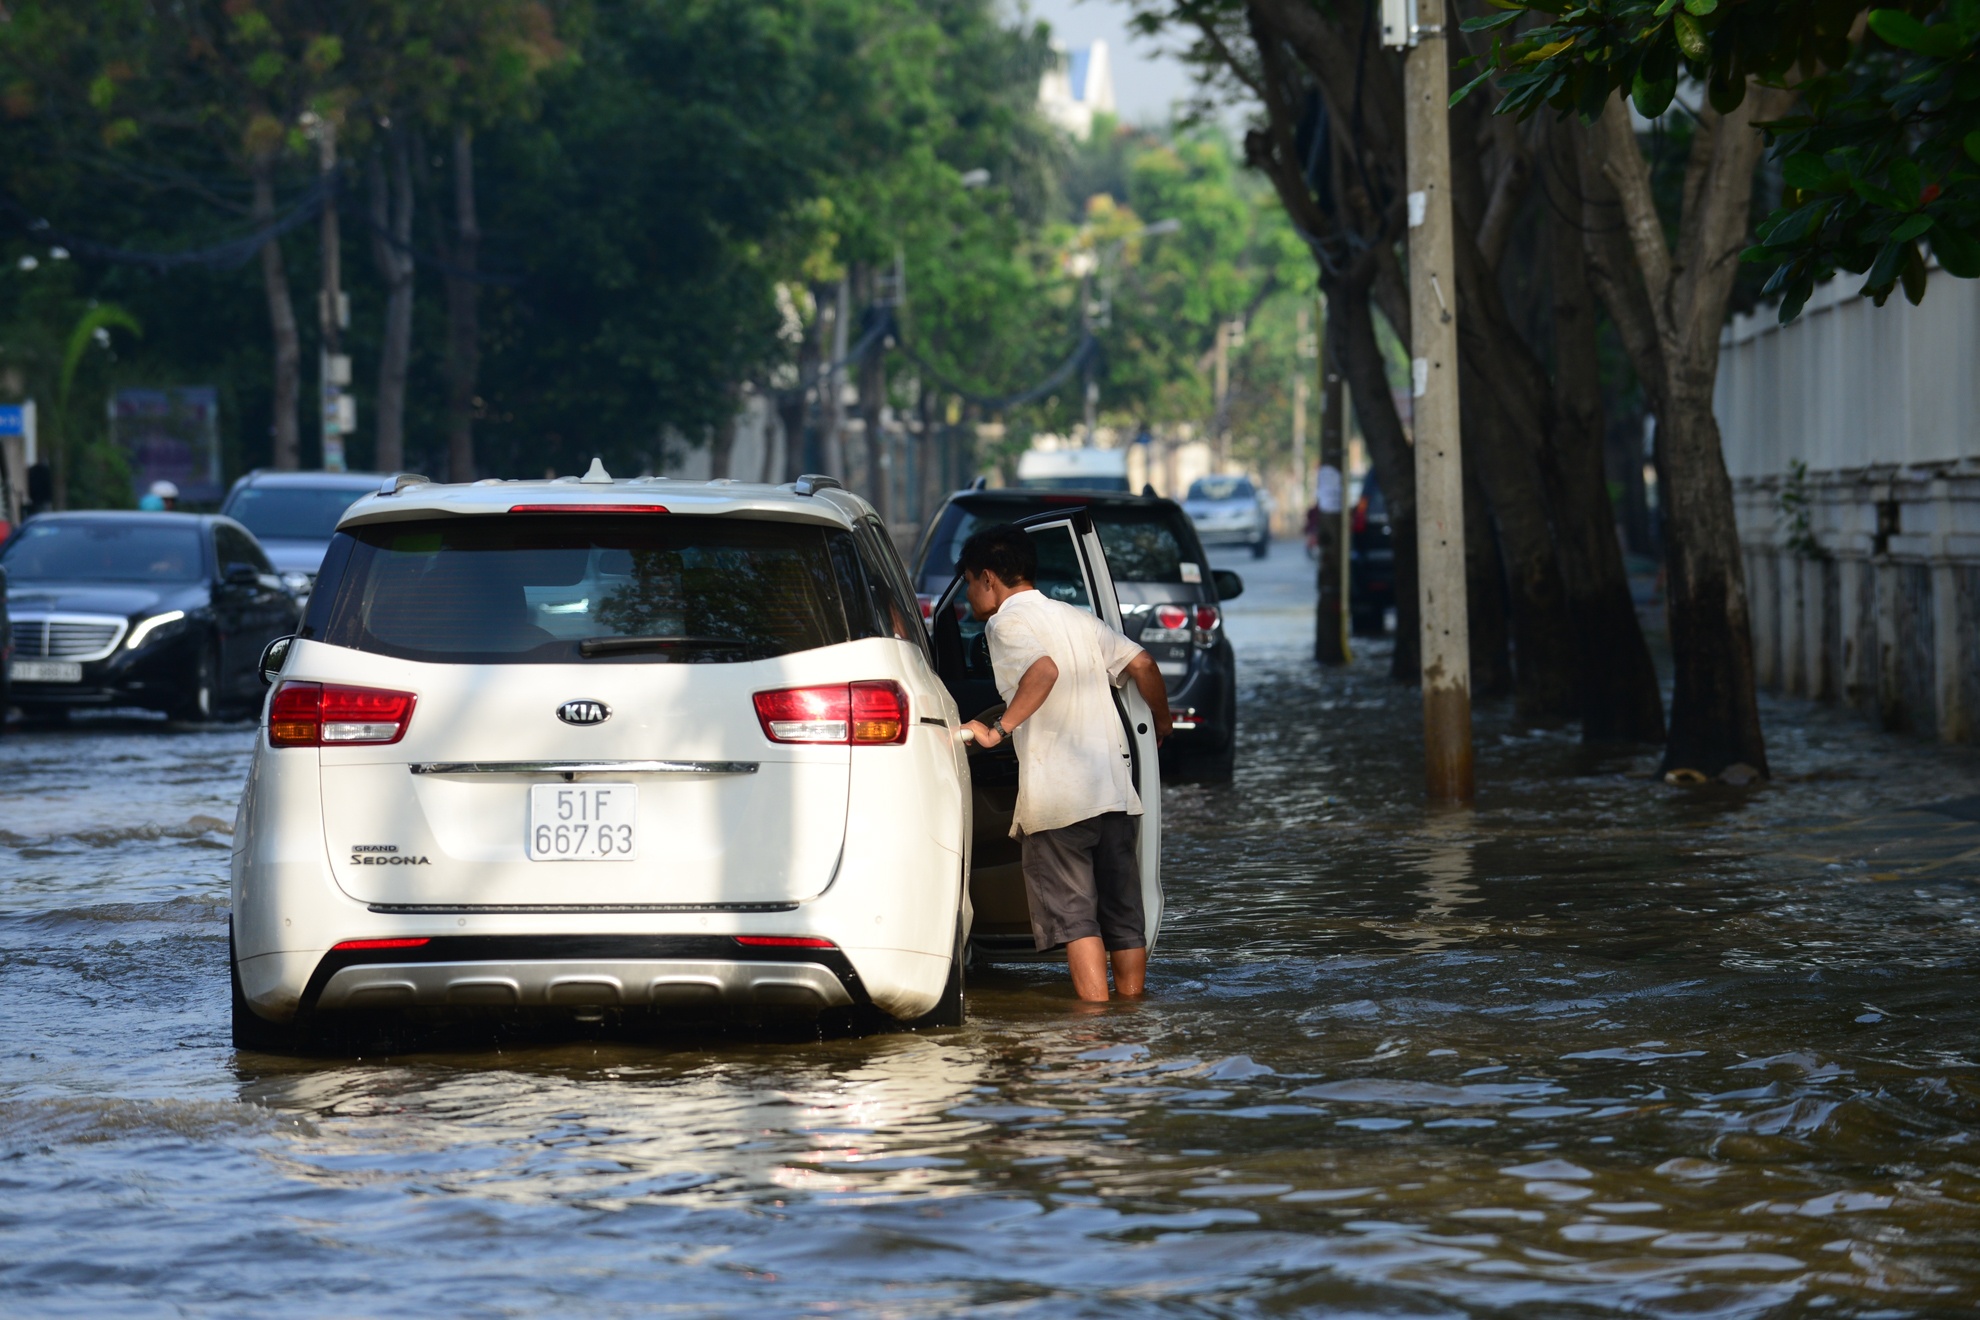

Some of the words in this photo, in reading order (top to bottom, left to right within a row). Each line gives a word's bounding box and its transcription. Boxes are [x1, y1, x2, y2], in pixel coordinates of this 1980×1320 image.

[565, 704, 603, 721] KIA
[557, 790, 611, 821] 51F
[536, 824, 632, 856] 667.63
[350, 854, 432, 865] SEDONA
